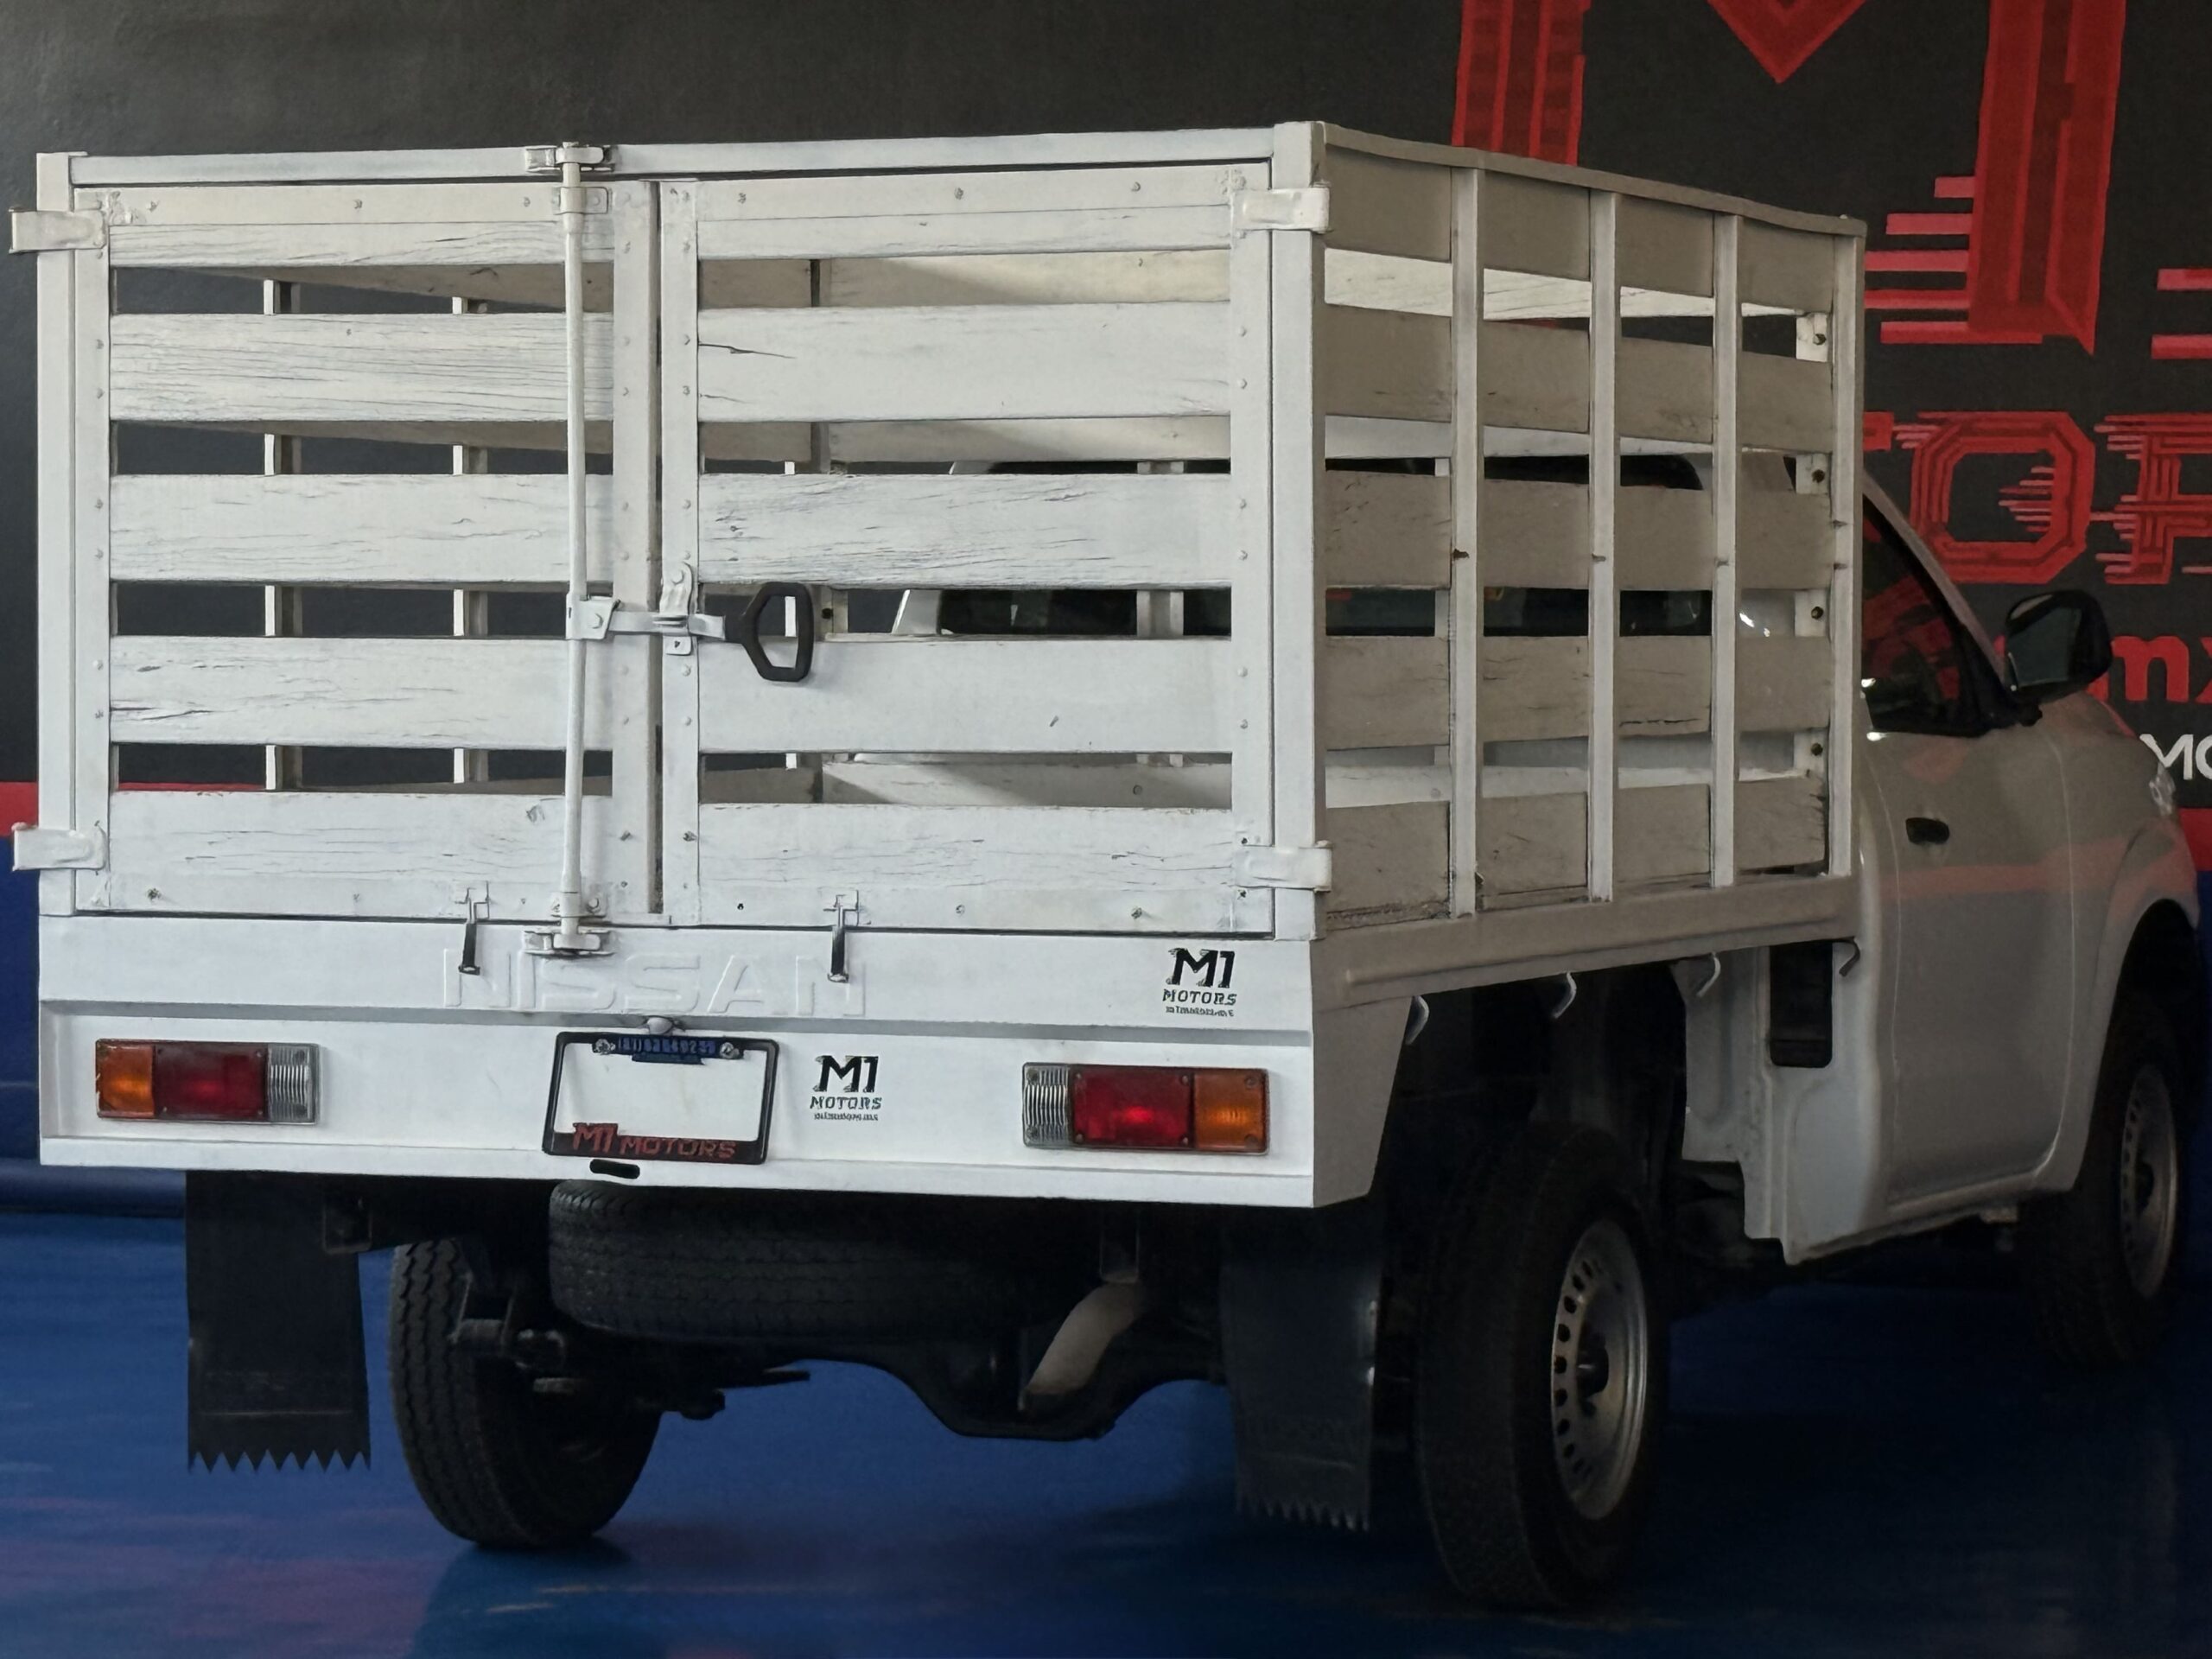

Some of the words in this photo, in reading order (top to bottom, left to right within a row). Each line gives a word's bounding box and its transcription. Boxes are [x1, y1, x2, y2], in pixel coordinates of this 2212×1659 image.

[443, 948, 865, 1016] NISSAN
[1162, 988, 1237, 1006] MOTORS
[810, 1096, 882, 1109] MOTORS
[619, 1133, 737, 1160] MOTORS
